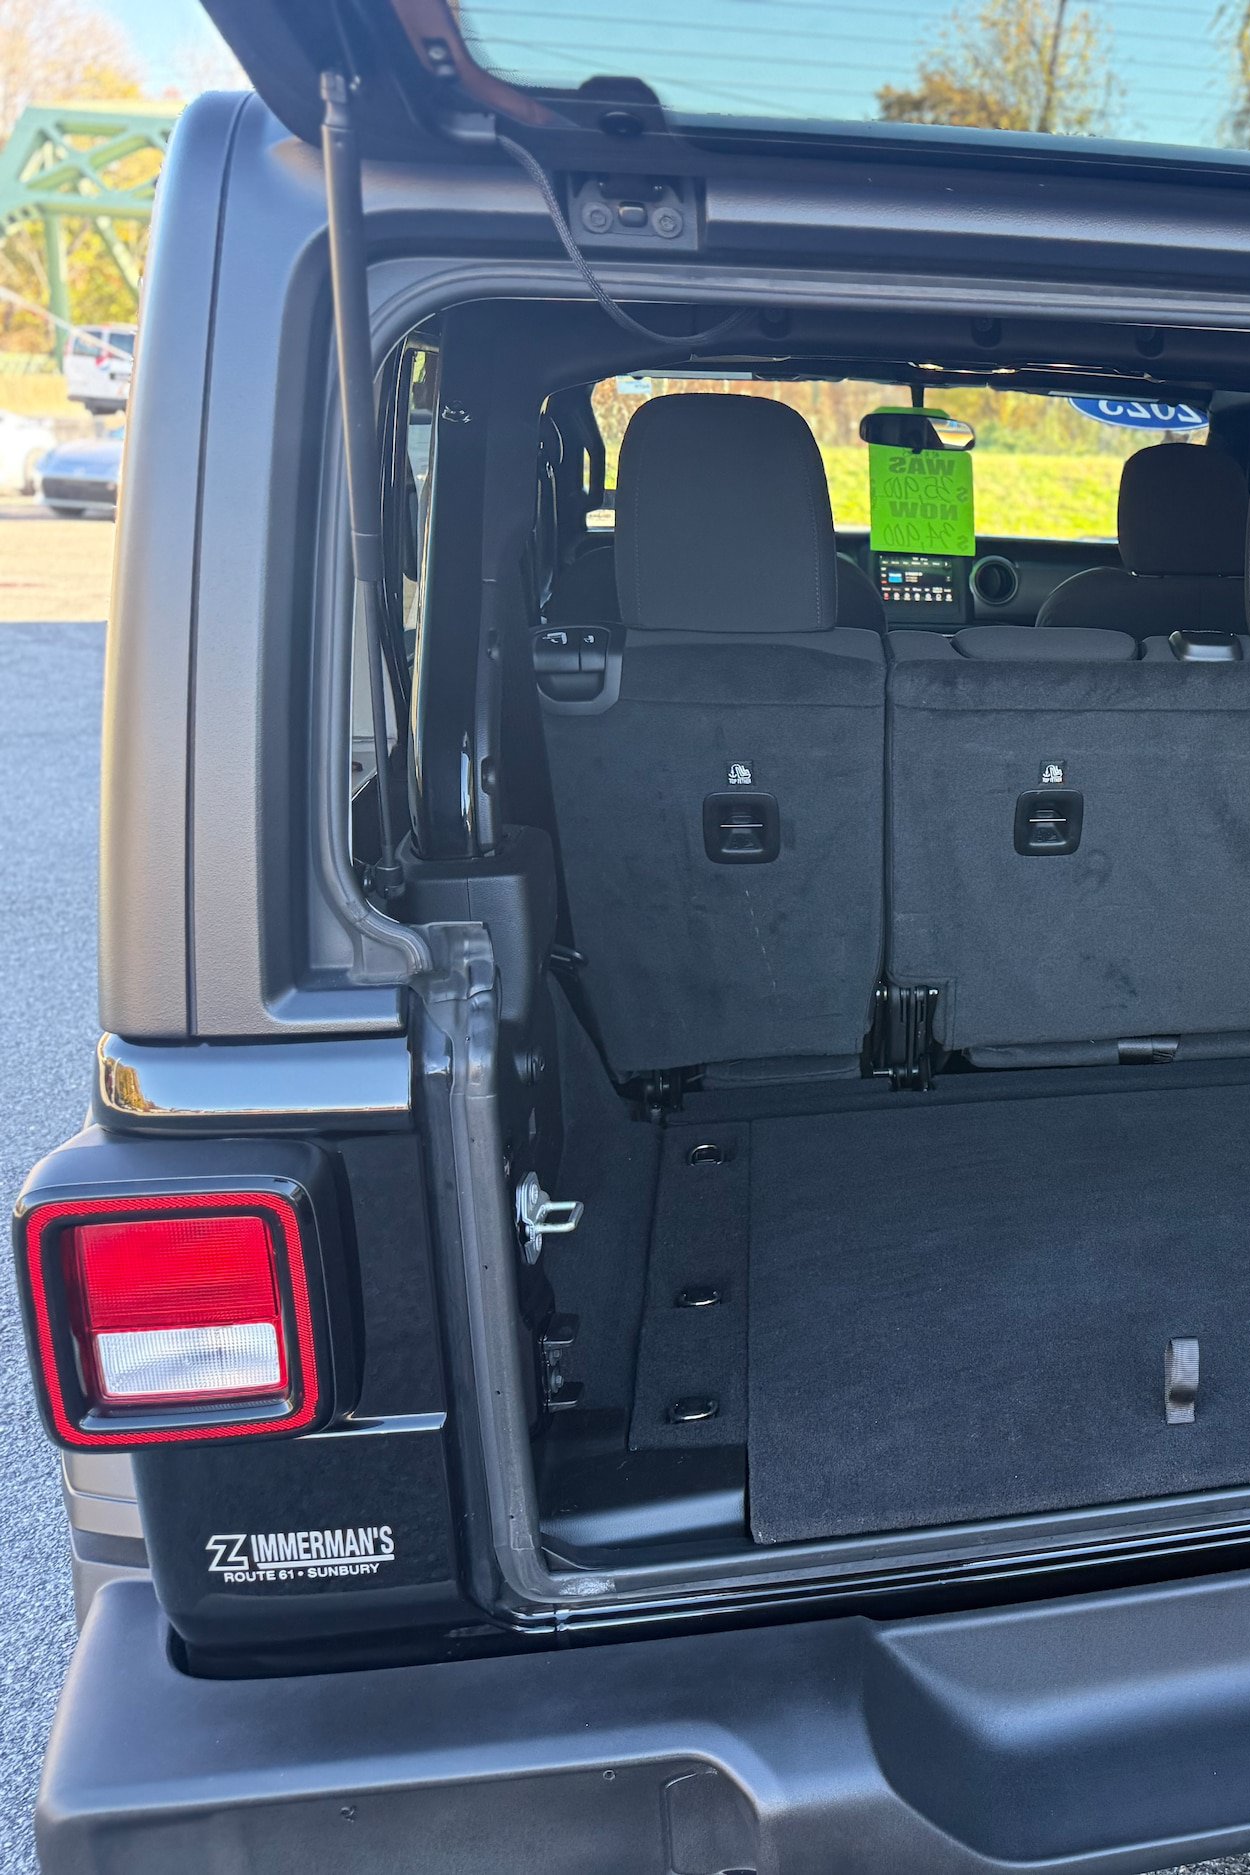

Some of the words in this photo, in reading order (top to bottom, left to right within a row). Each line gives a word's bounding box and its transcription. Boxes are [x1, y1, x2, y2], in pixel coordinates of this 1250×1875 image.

[205, 1525, 395, 1572] ZIMMERMAN'S
[223, 1570, 276, 1583] ROUTE
[278, 1568, 295, 1580] 61
[307, 1563, 380, 1579] SUNBURY
